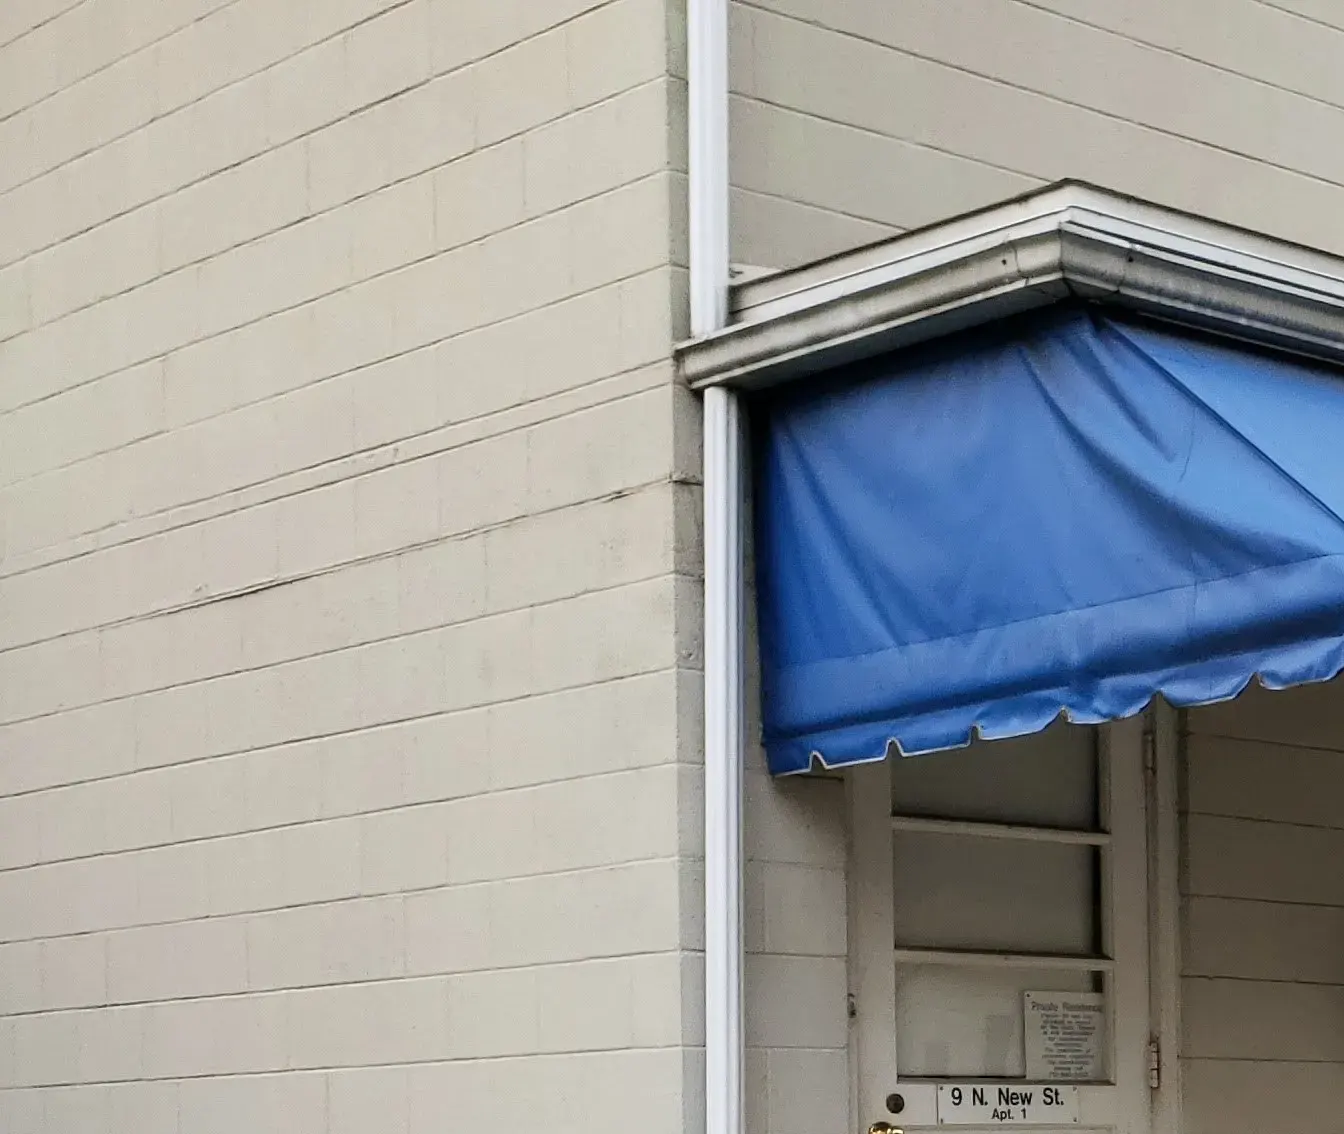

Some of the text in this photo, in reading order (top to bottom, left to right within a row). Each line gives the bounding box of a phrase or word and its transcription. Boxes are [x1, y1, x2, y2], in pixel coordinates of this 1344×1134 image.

[951, 1087, 1064, 1106] 9 N. New St.
[991, 1107, 1027, 1122] Apt. 1
